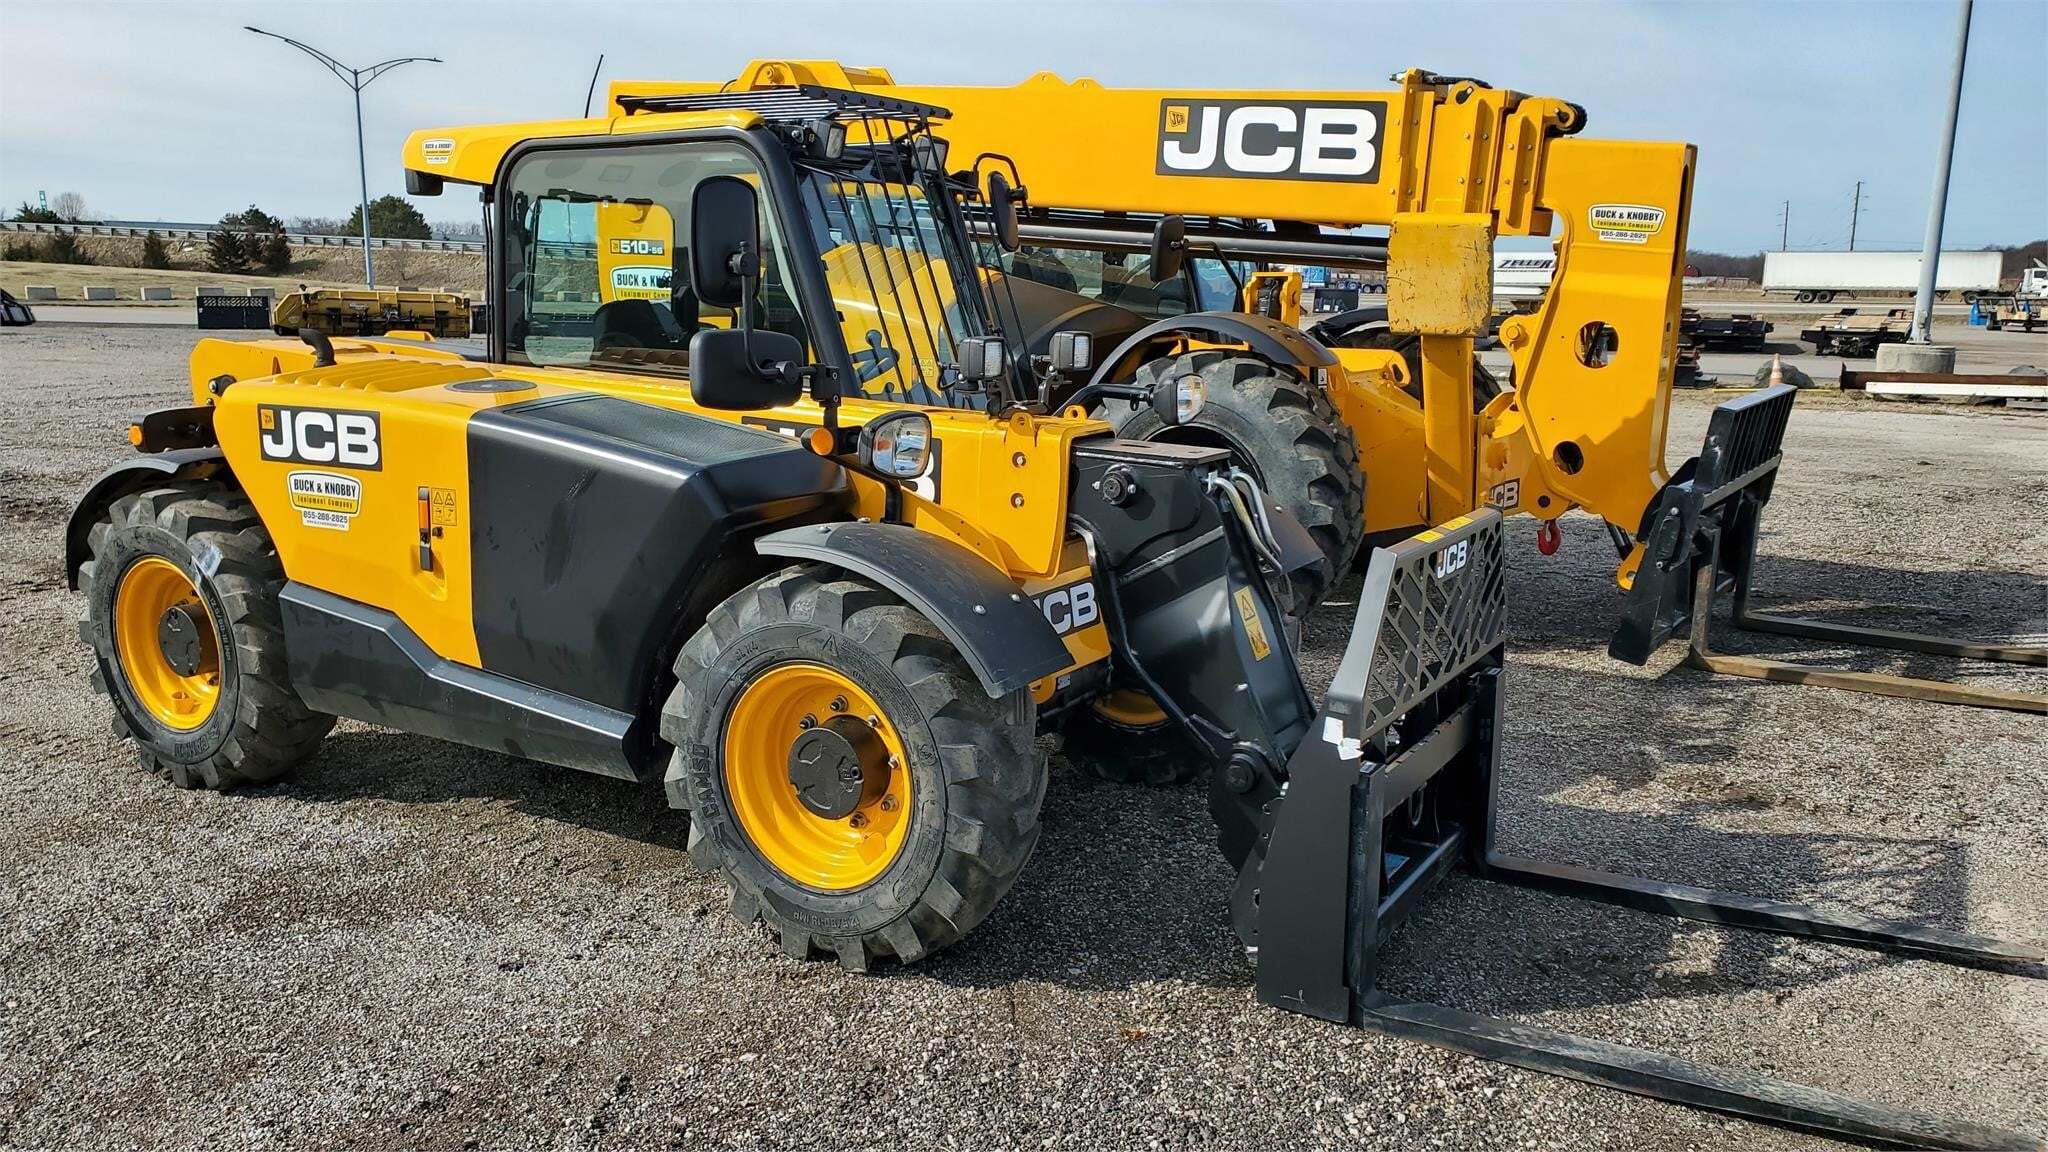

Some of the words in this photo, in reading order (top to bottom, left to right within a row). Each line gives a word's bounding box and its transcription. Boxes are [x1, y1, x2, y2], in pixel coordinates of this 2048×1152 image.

[1163, 106, 1377, 175] JCB
[1595, 209, 1617, 219] BUCK
[1627, 211, 1660, 222] KNOBBY
[620, 240, 663, 254] 510-56
[1497, 259, 1554, 269] ZELLER
[616, 273, 640, 286] BUCK
[641, 276, 648, 287] &
[653, 291, 672, 299] Comp
[262, 410, 379, 466] JCB
[294, 479, 315, 492] BUCK
[317, 483, 323, 493] &
[325, 482, 356, 498] KNOBBY
[1491, 481, 1519, 508] CB
[298, 495, 326, 505] Equipment
[328, 498, 353, 509] Company
[1437, 539, 1468, 579] JCB
[1033, 582, 1098, 634] CB
[692, 743, 721, 819] CAMSO
